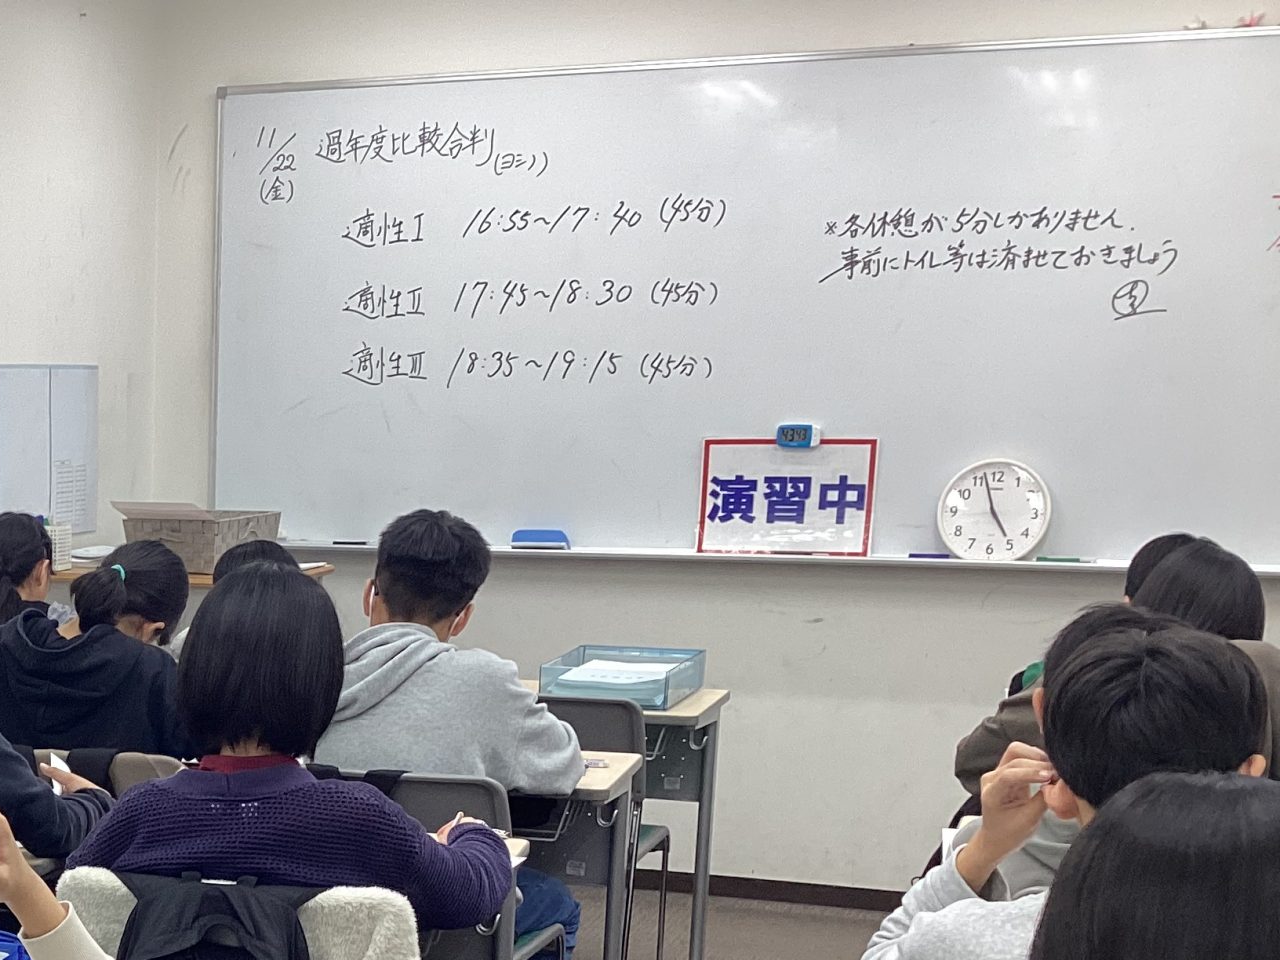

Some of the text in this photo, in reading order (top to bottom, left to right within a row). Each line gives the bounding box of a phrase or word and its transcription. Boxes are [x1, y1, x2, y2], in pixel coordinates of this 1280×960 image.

[260, 175, 295, 205] (金)
[659, 192, 727, 233] (45分)
[650, 277, 718, 308] (45分)
[640, 352, 713, 385] (45分)
[972, 475, 984, 487] 11
[991, 471, 1005, 483] 12
[1015, 476, 1021, 488] 1
[706, 474, 867, 525] 演習中
[958, 488, 971, 500] 10
[950, 506, 958, 518] 9
[1030, 508, 1038, 520] 3
[954, 525, 962, 537] 8
[1020, 527, 1029, 539] 4
[968, 538, 976, 549] 7
[985, 543, 994, 555] 6
[1006, 539, 1014, 551] 5
